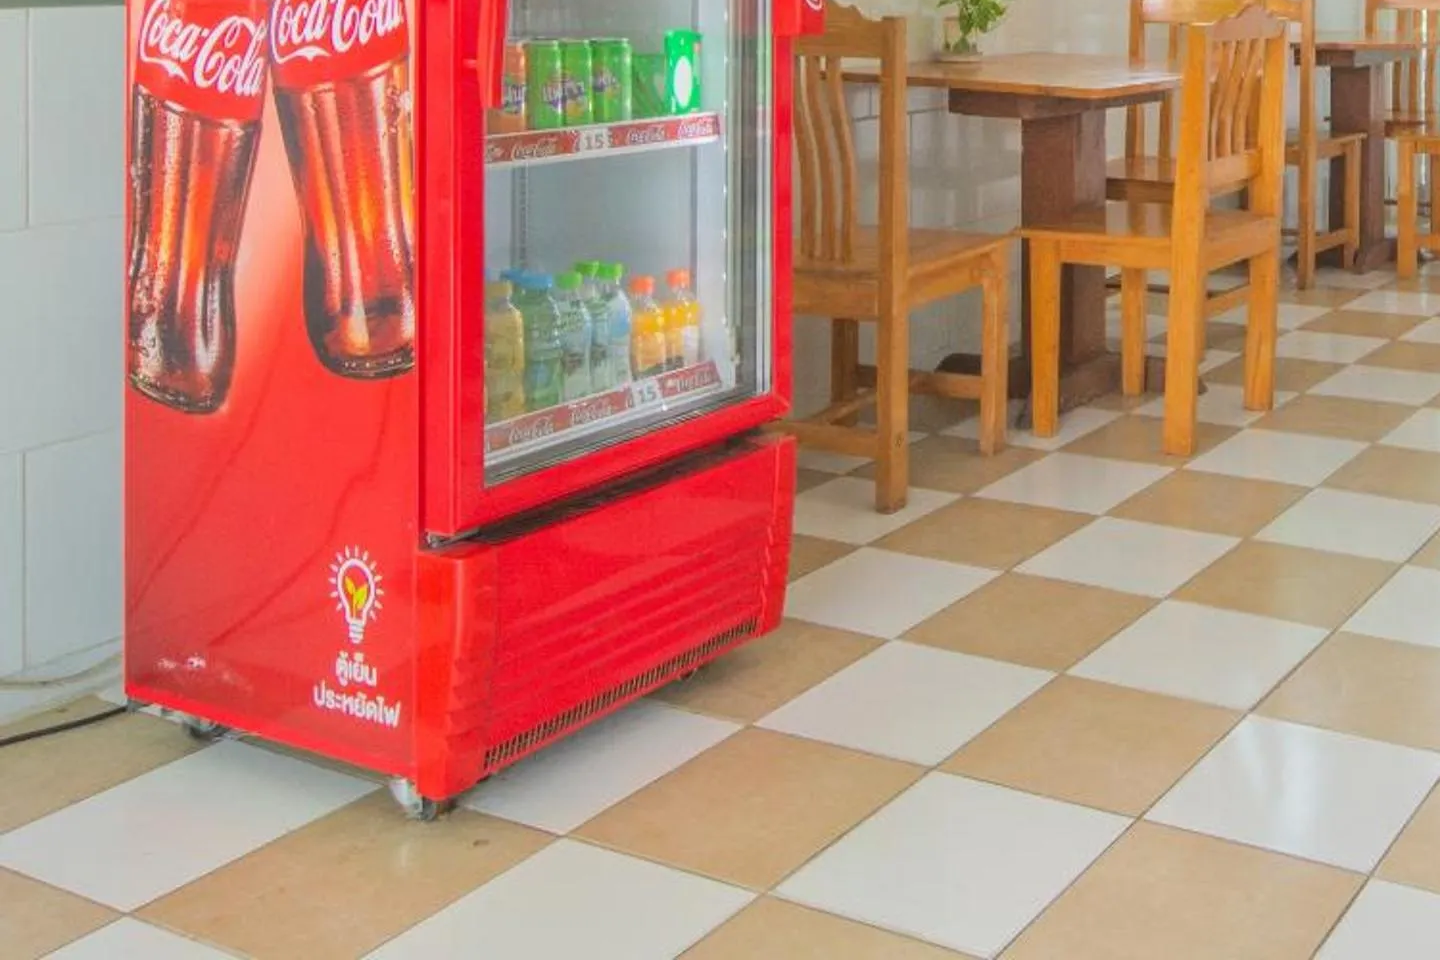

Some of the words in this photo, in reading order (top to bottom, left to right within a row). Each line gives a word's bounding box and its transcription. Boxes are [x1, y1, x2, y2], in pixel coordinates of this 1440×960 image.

[585, 134, 604, 151] 15
[638, 386, 656, 403] 15
[313, 678, 401, 728] ประหยัดไฟ
